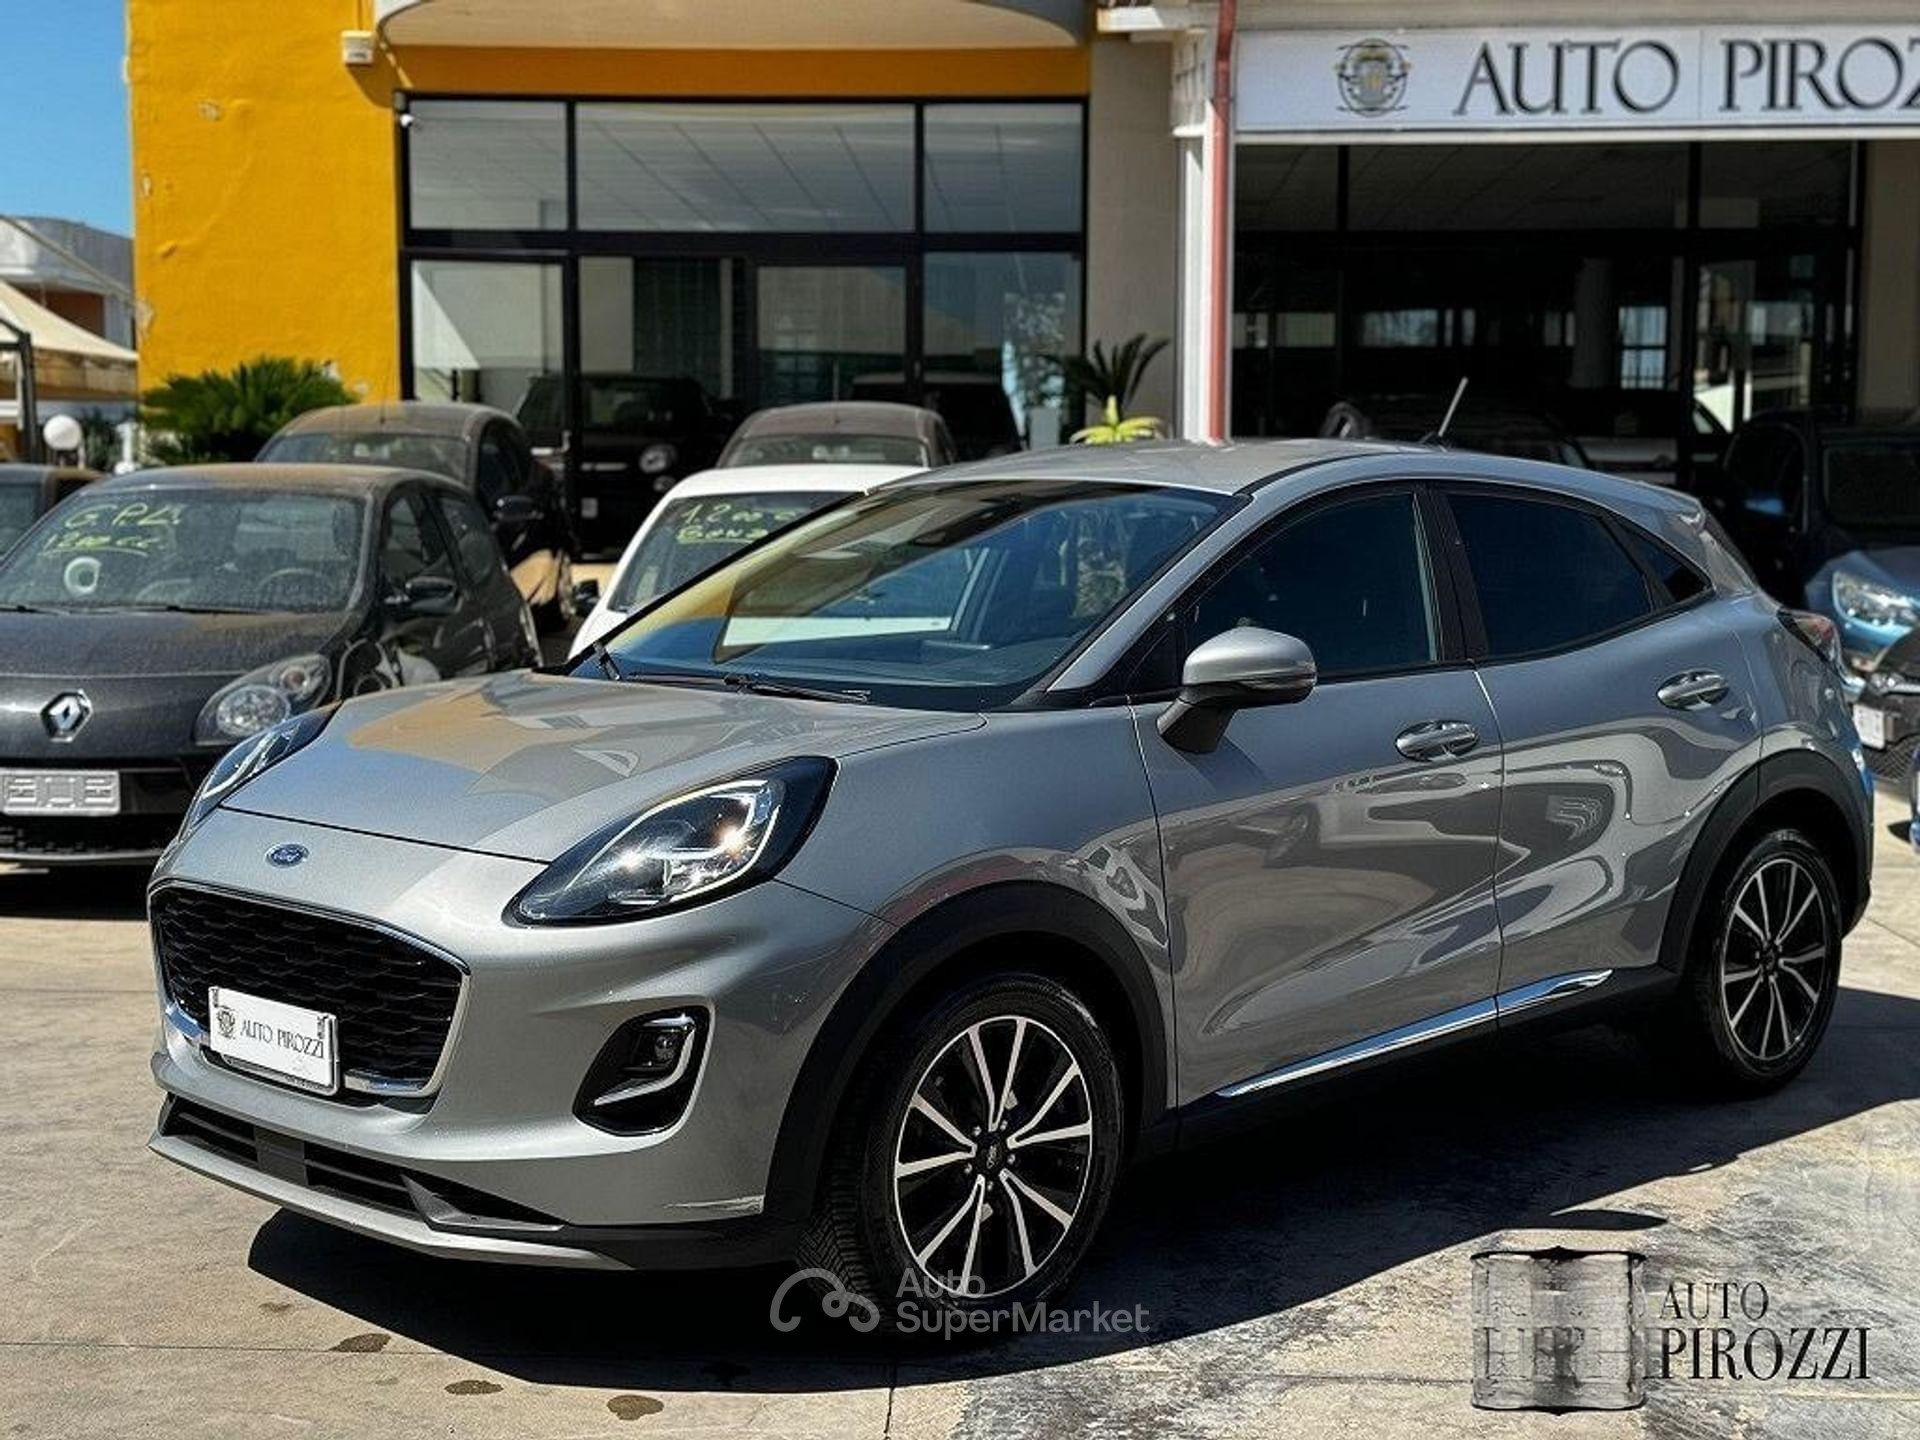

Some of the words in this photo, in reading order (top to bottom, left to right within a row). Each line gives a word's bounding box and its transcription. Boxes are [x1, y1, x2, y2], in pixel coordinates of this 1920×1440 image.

[1452, 40, 1680, 116] AUTO
[240, 1019, 273, 1044] AUTO
[277, 1027, 324, 1059] PIROZZI
